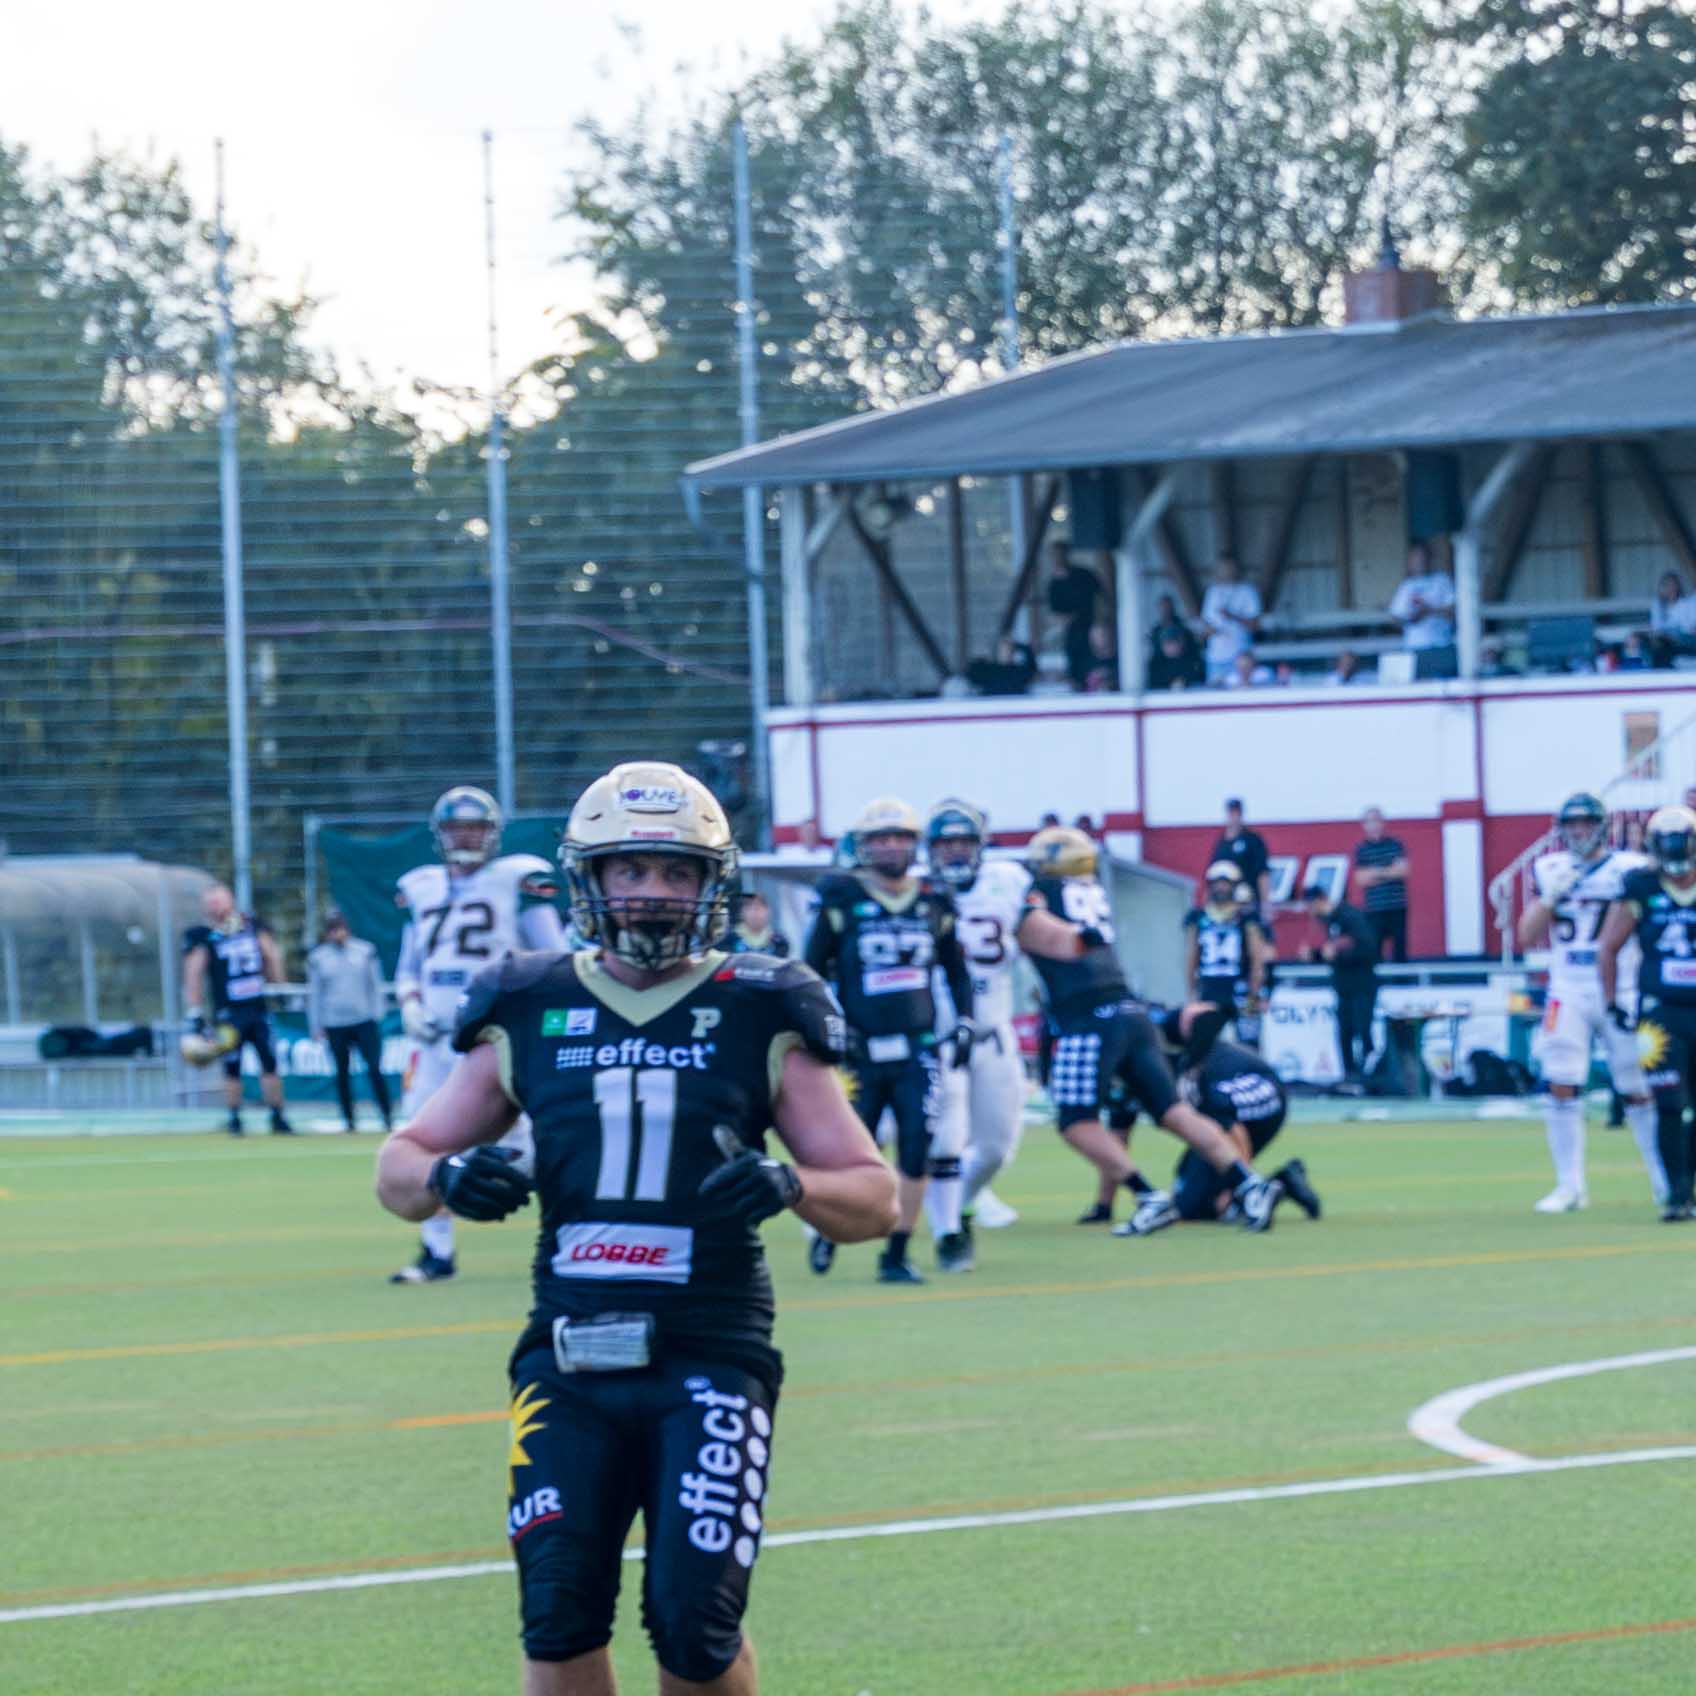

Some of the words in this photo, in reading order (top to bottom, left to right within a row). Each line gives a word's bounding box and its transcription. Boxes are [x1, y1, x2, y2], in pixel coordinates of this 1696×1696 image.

[422, 901, 495, 958] 72
[593, 1066, 679, 1201] 11
[571, 1243, 670, 1267] LOBBE
